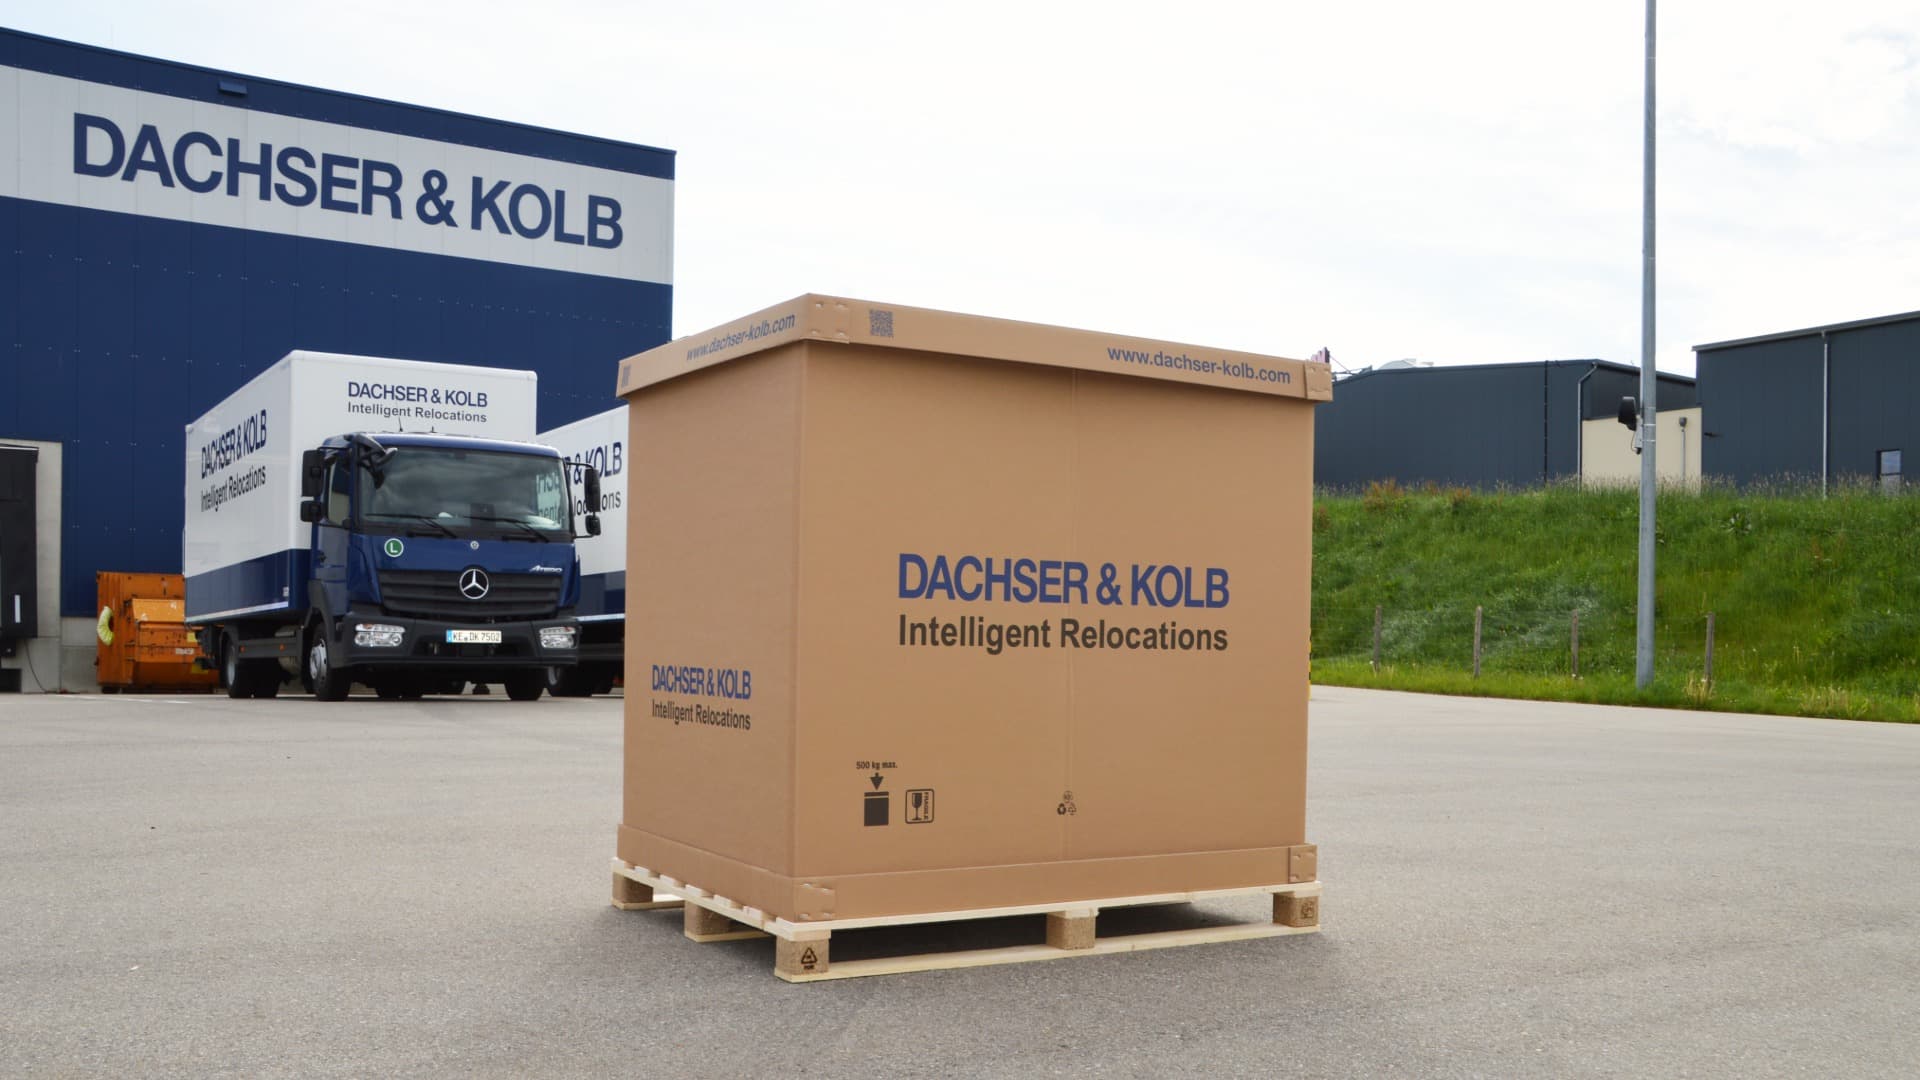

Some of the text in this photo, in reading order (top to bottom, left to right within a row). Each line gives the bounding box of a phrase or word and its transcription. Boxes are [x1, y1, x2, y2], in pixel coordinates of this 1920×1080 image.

[73, 112, 623, 249] DACHSER & KOLB
[686, 313, 796, 361] www.dachser-kolb.com
[1106, 347, 1291, 384] www.dachser-kolb.com
[348, 382, 488, 407] DACHSER & KOLB
[348, 402, 487, 422] Intelligent Relocations
[201, 409, 267, 479] DACHSER & KOLB
[574, 453, 582, 485] &
[201, 465, 266, 512] Intelligent Relocations
[389, 542, 398, 553] L
[898, 553, 1230, 608] DACHSER & KOLB
[898, 614, 1228, 655] Intelligent Relocations
[652, 664, 751, 700] DACHSER & KOLB
[652, 699, 751, 731] Intelligent Relocations
[856, 760, 870, 769] 500
[871, 761, 880, 770] kg
